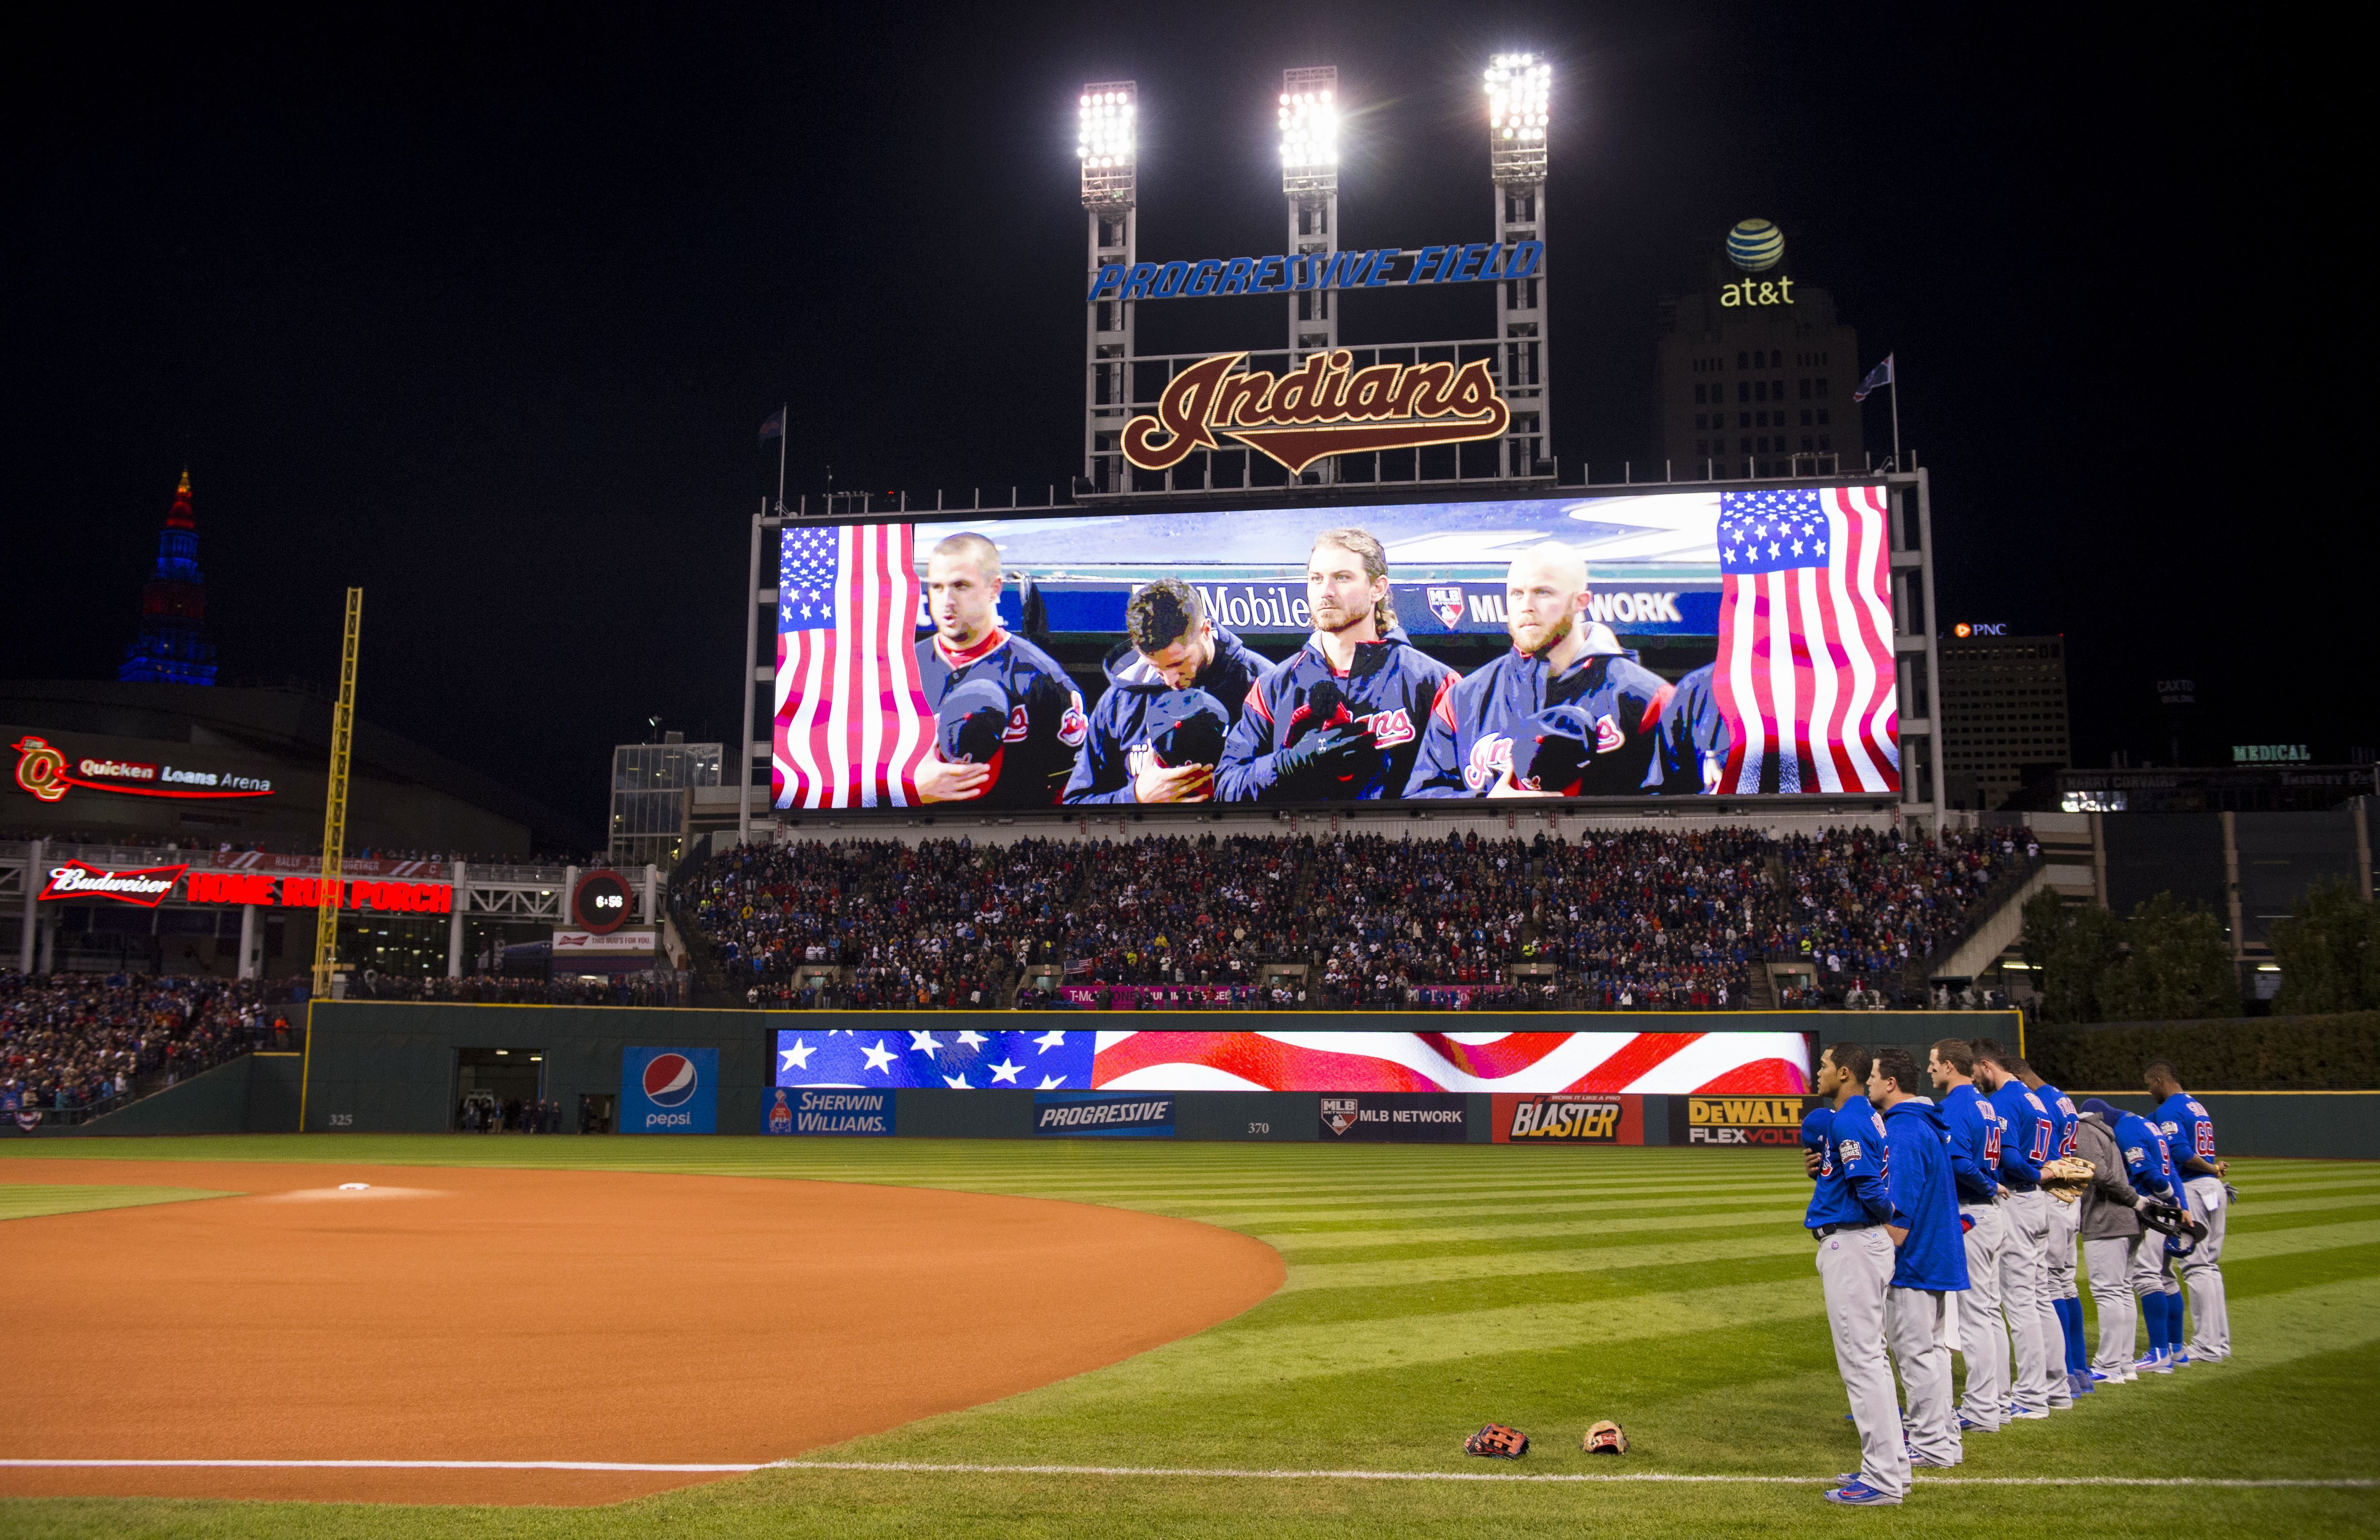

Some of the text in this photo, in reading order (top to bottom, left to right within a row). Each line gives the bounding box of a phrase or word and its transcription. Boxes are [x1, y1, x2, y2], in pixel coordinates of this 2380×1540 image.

[1087, 240, 1545, 301] PROGRESSIVE FIELD
[1721, 275, 1794, 307] at&t
[1120, 349, 1510, 476] Indians
[1196, 586, 1311, 628] Mobile
[1429, 589, 1460, 601] MLB
[1973, 623, 2007, 636] PNC
[2231, 744, 2312, 762] MEDICAL
[18, 748, 67, 801] Q
[79, 759, 271, 792] Quicken Loans Arena
[50, 868, 172, 893] Budweiser
[187, 872, 452, 913] HOME RUN PORCH
[596, 895, 623, 908] 6:56
[799, 1092, 883, 1110] SHERWIN
[1323, 1100, 1355, 1111] MLB
[329, 1114, 352, 1126] 325
[646, 1111, 691, 1128] pepsi
[1039, 1101, 1169, 1127] PROGRESSIVE
[1360, 1110, 1463, 1123] MLB NETWORK
[1511, 1103, 1619, 1137] BLASTER
[1247, 1122, 1269, 1134] 370
[1689, 1128, 1801, 1144] FLEXVOLT
[2029, 1117, 2052, 1162] 17
[2058, 1120, 2080, 1158] 24
[2195, 1120, 2215, 1156] 68
[1840, 1143, 1859, 1154] WORLD
[1841, 1149, 1860, 1160] SERIES
[1983, 1125, 2001, 1171] 44
[2158, 1138, 2171, 1176] 9
